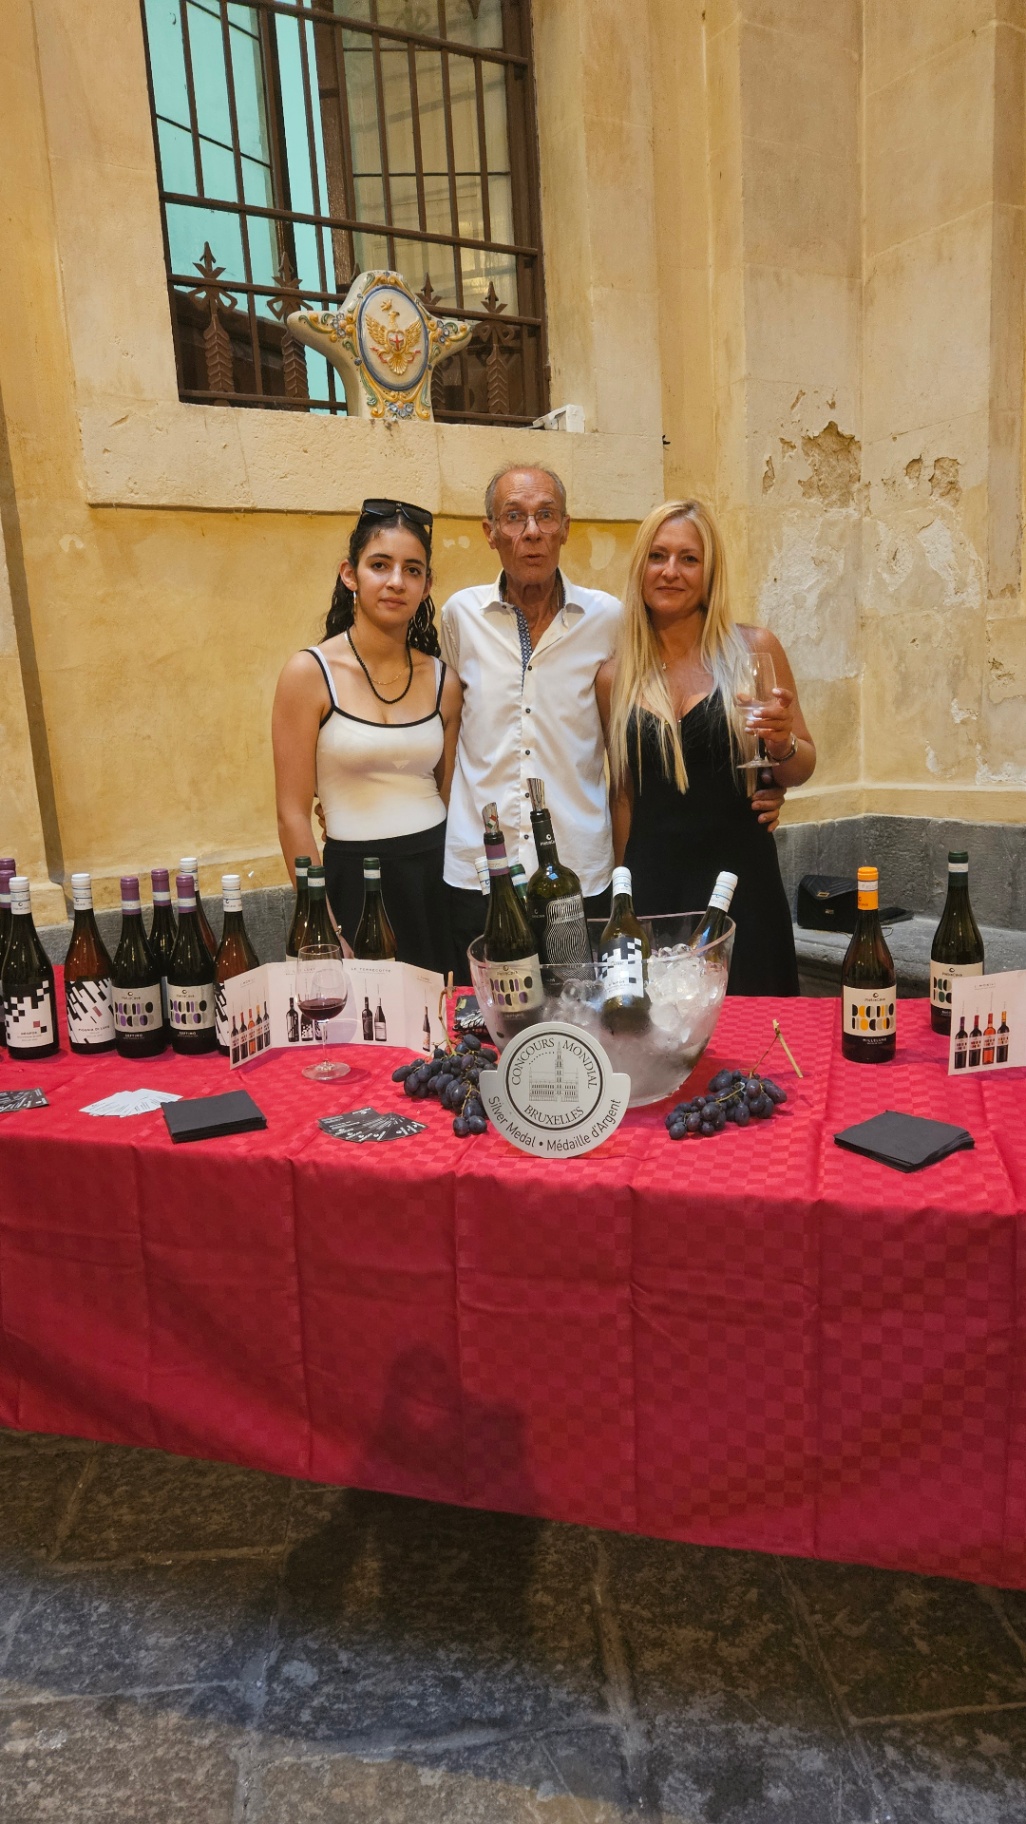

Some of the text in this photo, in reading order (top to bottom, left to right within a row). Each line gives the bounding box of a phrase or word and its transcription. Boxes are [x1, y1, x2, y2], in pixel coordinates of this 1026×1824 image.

[511, 1037, 597, 1089] CONCOURS MONDIAL
[488, 1096, 621, 1151] Silver Medal Médaille d'Argent
[524, 1105, 584, 1125] BRUXELLES
